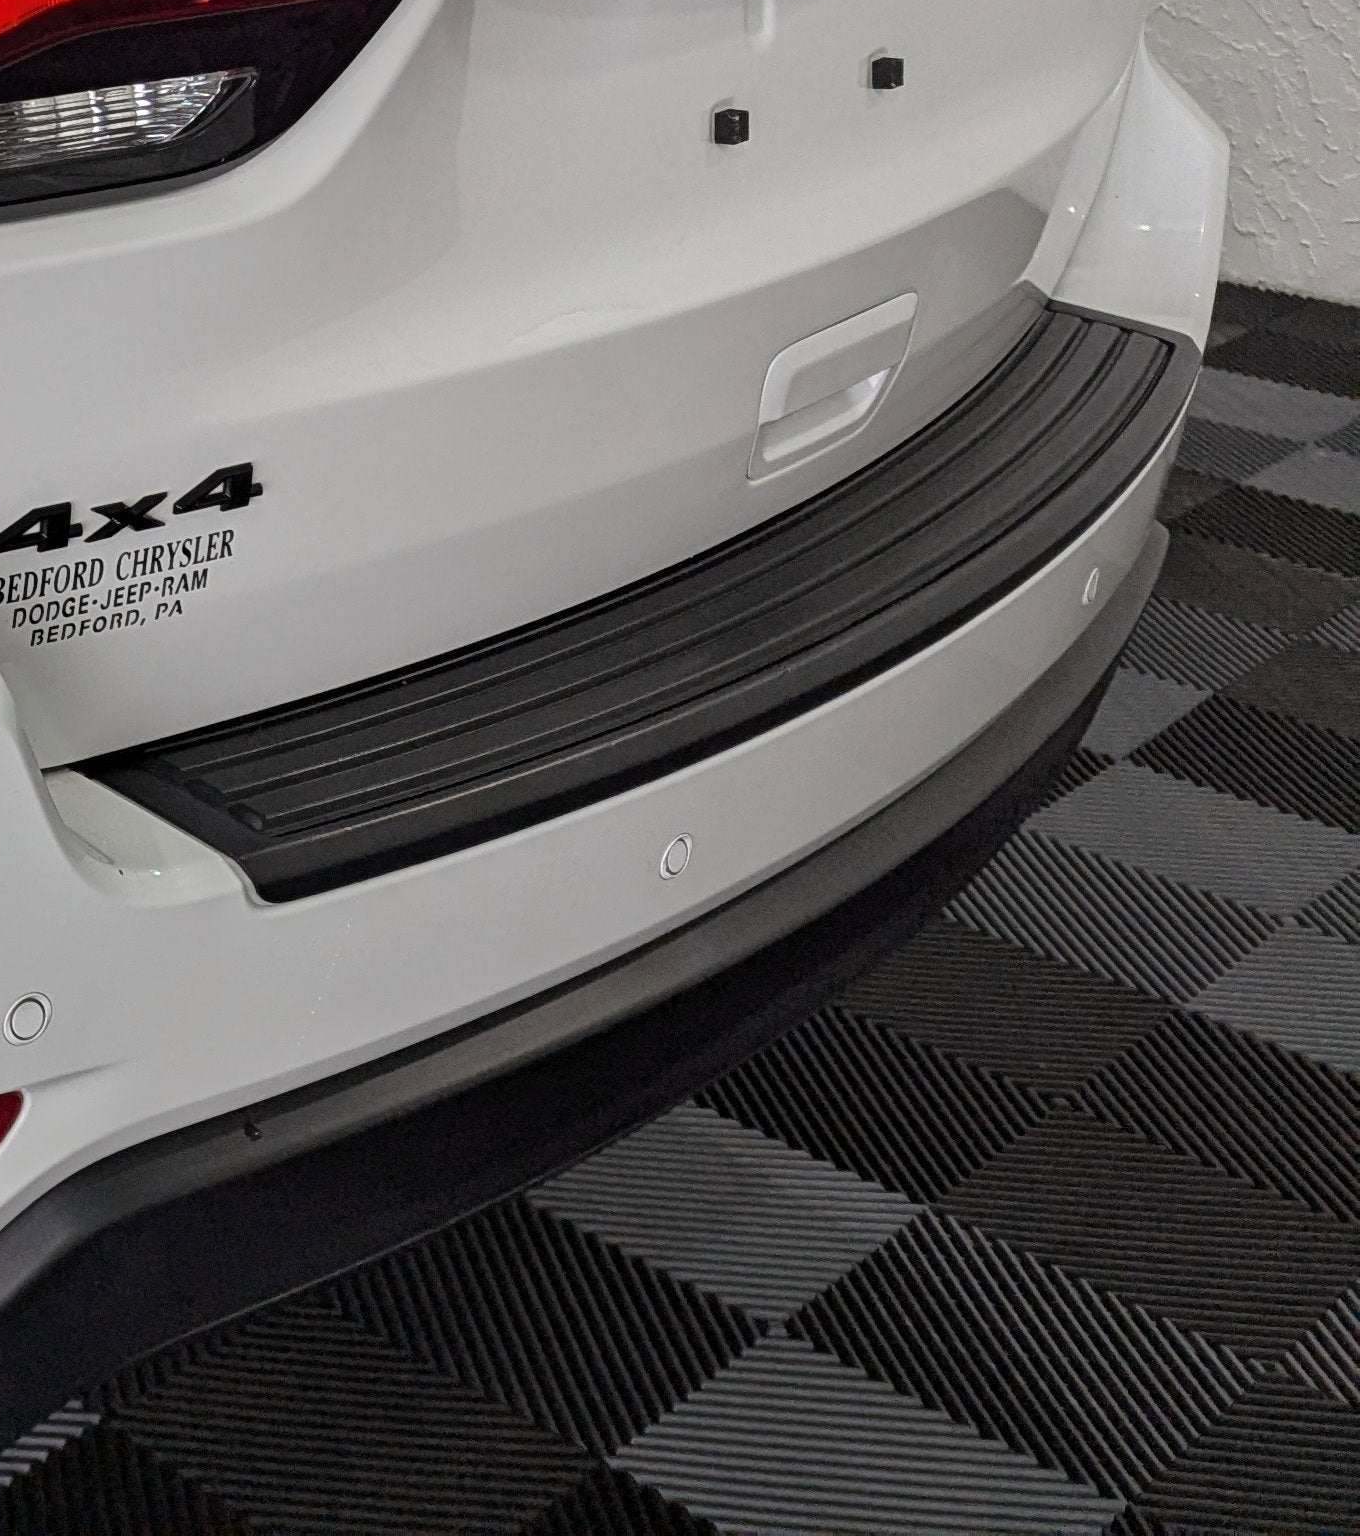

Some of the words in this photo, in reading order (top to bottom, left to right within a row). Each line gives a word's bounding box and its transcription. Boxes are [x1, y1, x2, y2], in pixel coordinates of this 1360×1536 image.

[114, 529, 236, 582] CHRYSLER
[29, 607, 147, 647] BEDFORD,
[154, 598, 184, 621] PA
